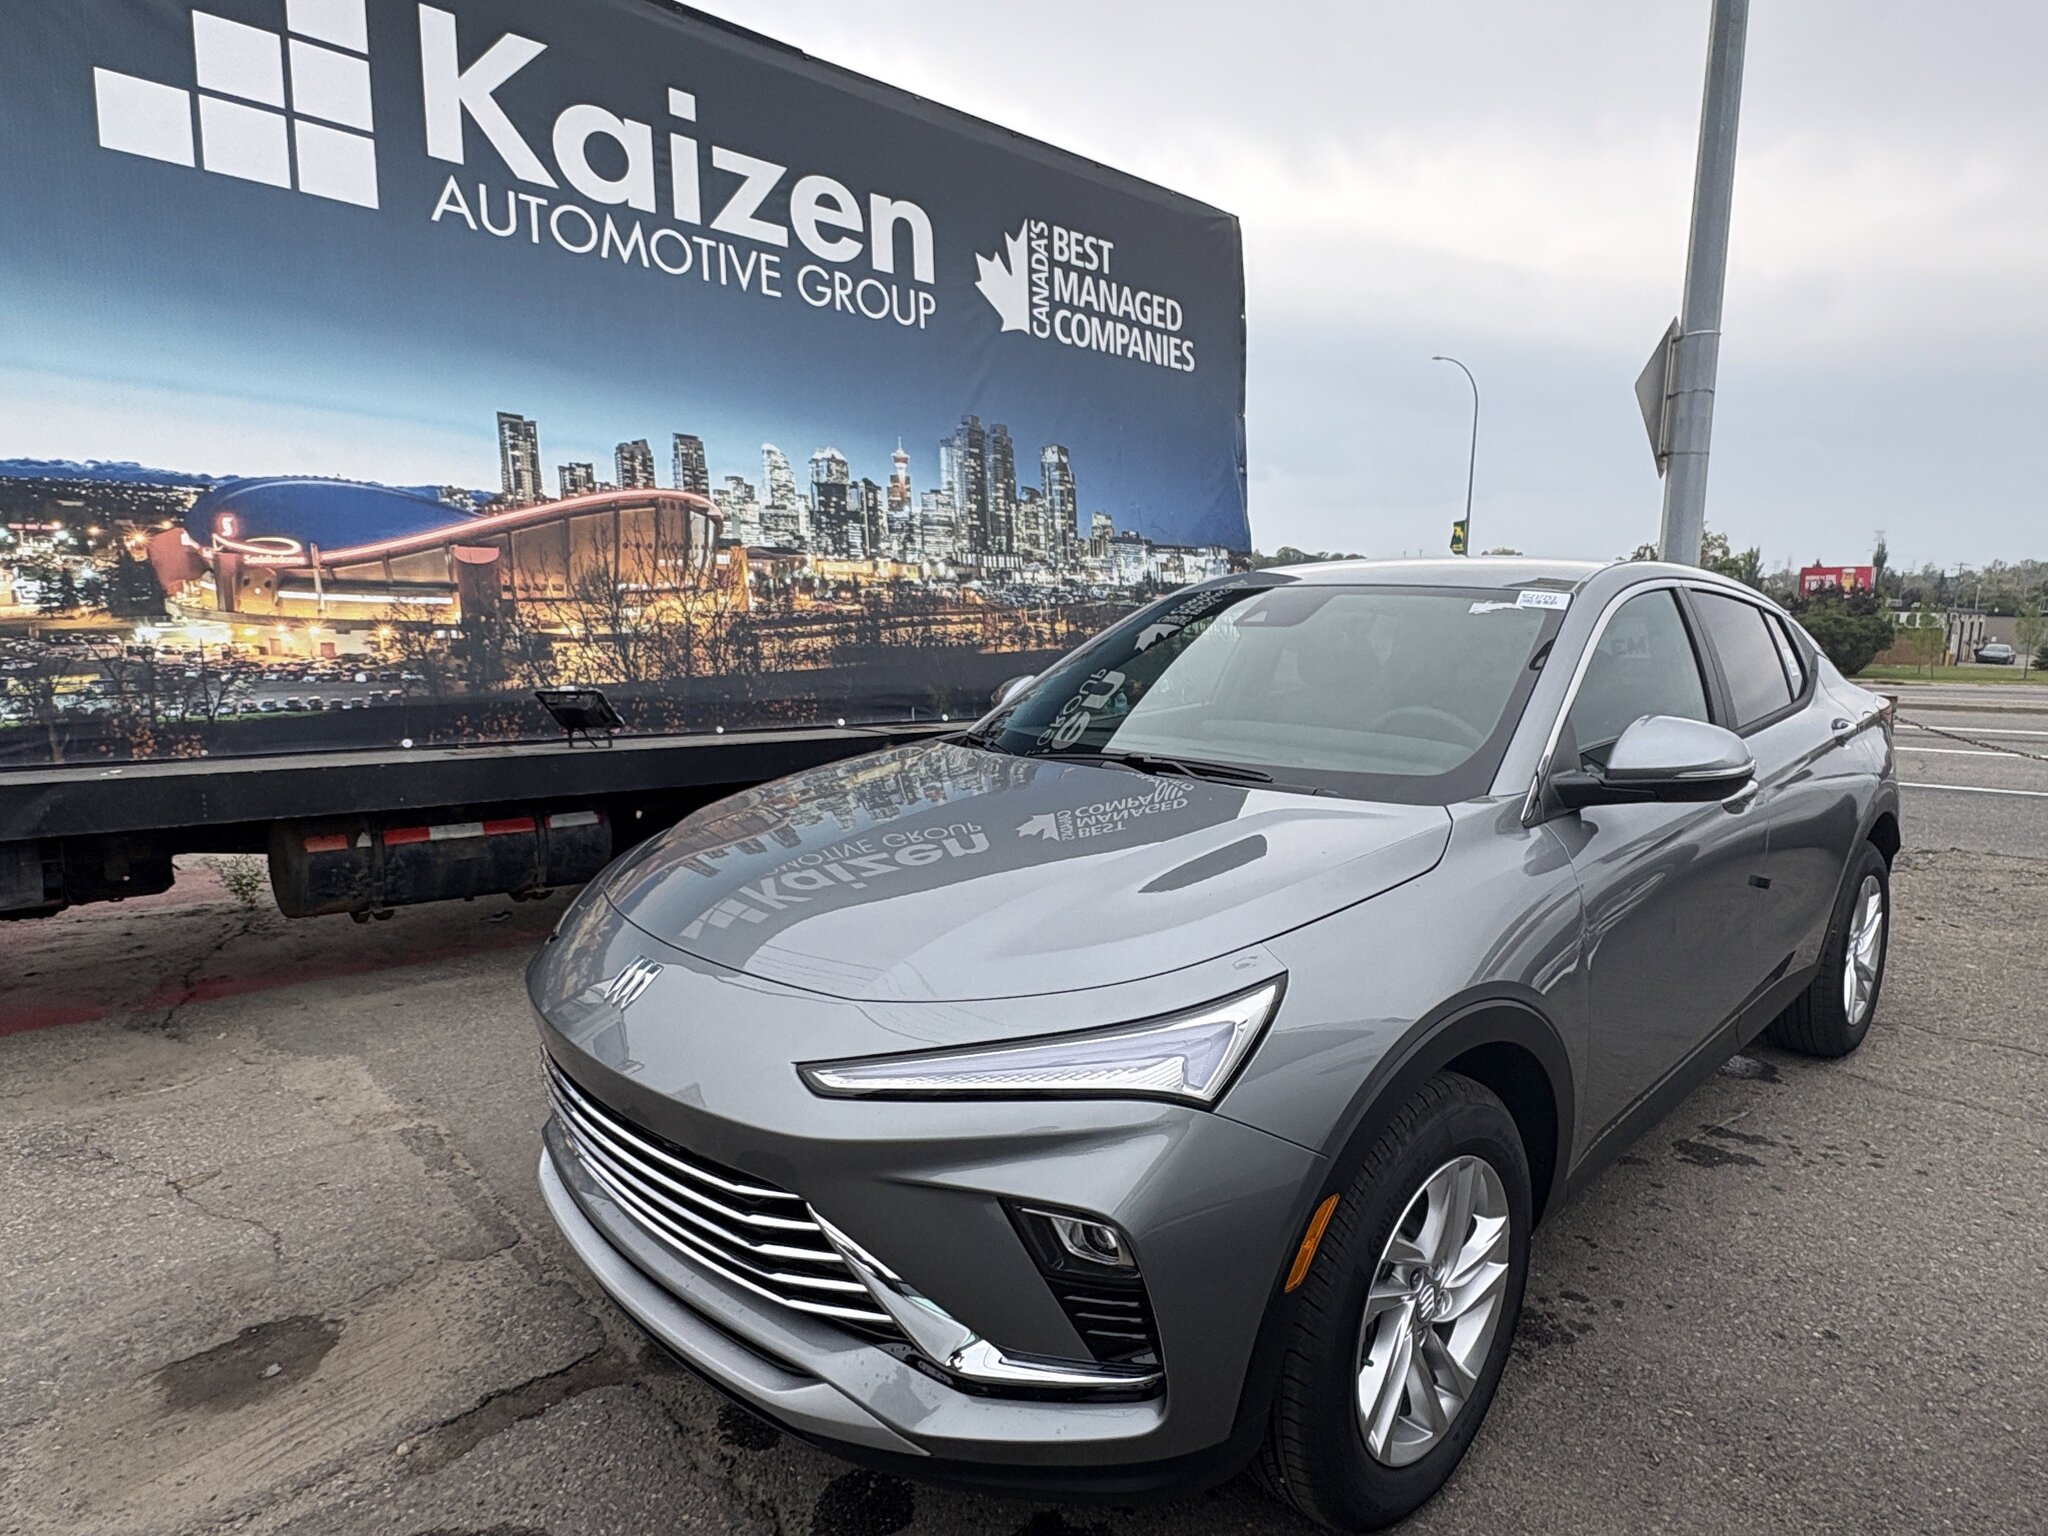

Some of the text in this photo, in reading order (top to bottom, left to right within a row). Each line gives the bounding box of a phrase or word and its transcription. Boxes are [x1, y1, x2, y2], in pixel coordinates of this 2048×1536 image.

[418, 3, 936, 285] Kaizen
[430, 174, 937, 330] AUTOMOTIVE GROUP
[1029, 218, 1051, 340] CANADA'S
[1052, 225, 1115, 275] BEST
[1053, 266, 1184, 333] MANAGED
[1053, 308, 1196, 373] COMPANIES
